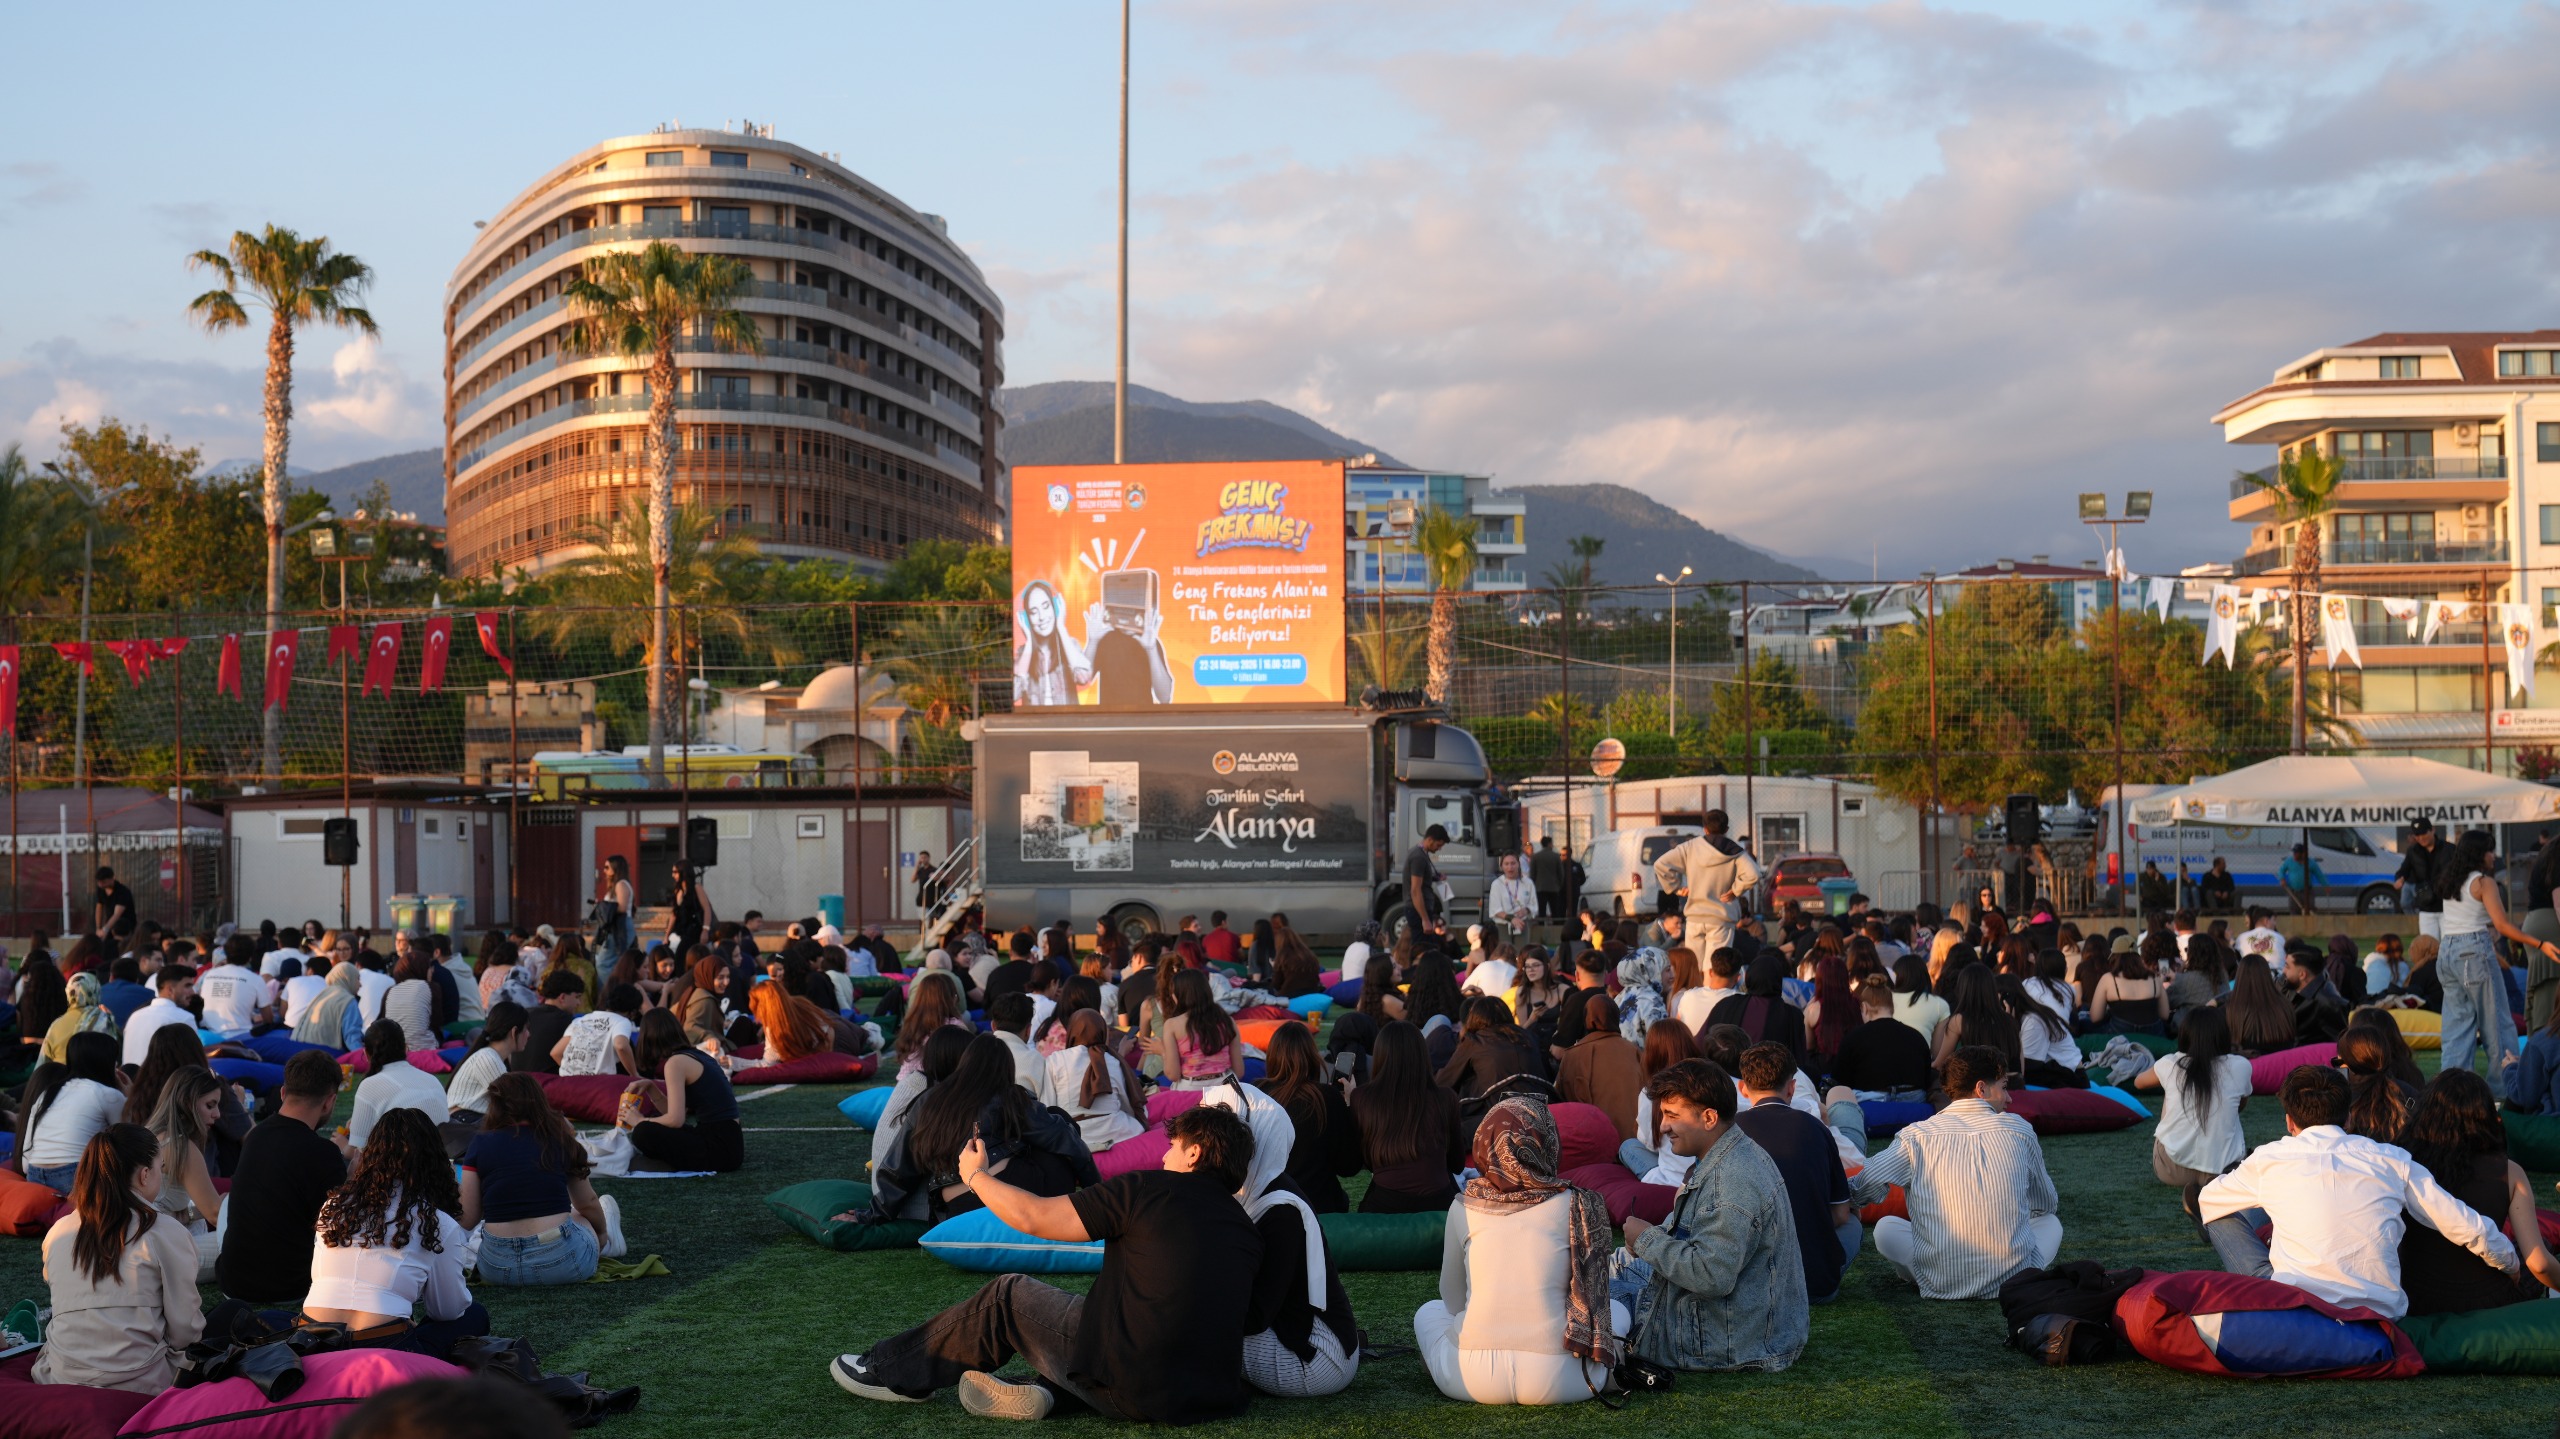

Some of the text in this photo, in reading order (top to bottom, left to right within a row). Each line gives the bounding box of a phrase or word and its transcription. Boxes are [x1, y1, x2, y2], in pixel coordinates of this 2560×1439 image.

[1219, 480, 1284, 512] GENÇ
[1196, 513, 1309, 551] FREKANS!
[1172, 579, 1328, 603] Genç Frekans Alanı'na
[1187, 602, 1312, 625] Tüm Gençlerimizi
[1209, 623, 1291, 650] Bekliyoruz!
[1237, 752, 1298, 763] ALANYA
[1237, 763, 1299, 772] BELEDİYESİ
[1206, 788, 1305, 810] Tarihin Şehri
[2266, 804, 2491, 823] ALANYA MUNICIPALITY
[1194, 808, 1317, 853] Alanya
[1170, 859, 1199, 868] Tarihin
[1221, 859, 1268, 870] Alanya'nın
[1269, 859, 1302, 870] Simgesi
[1304, 859, 1343, 868] Kızılkule!
